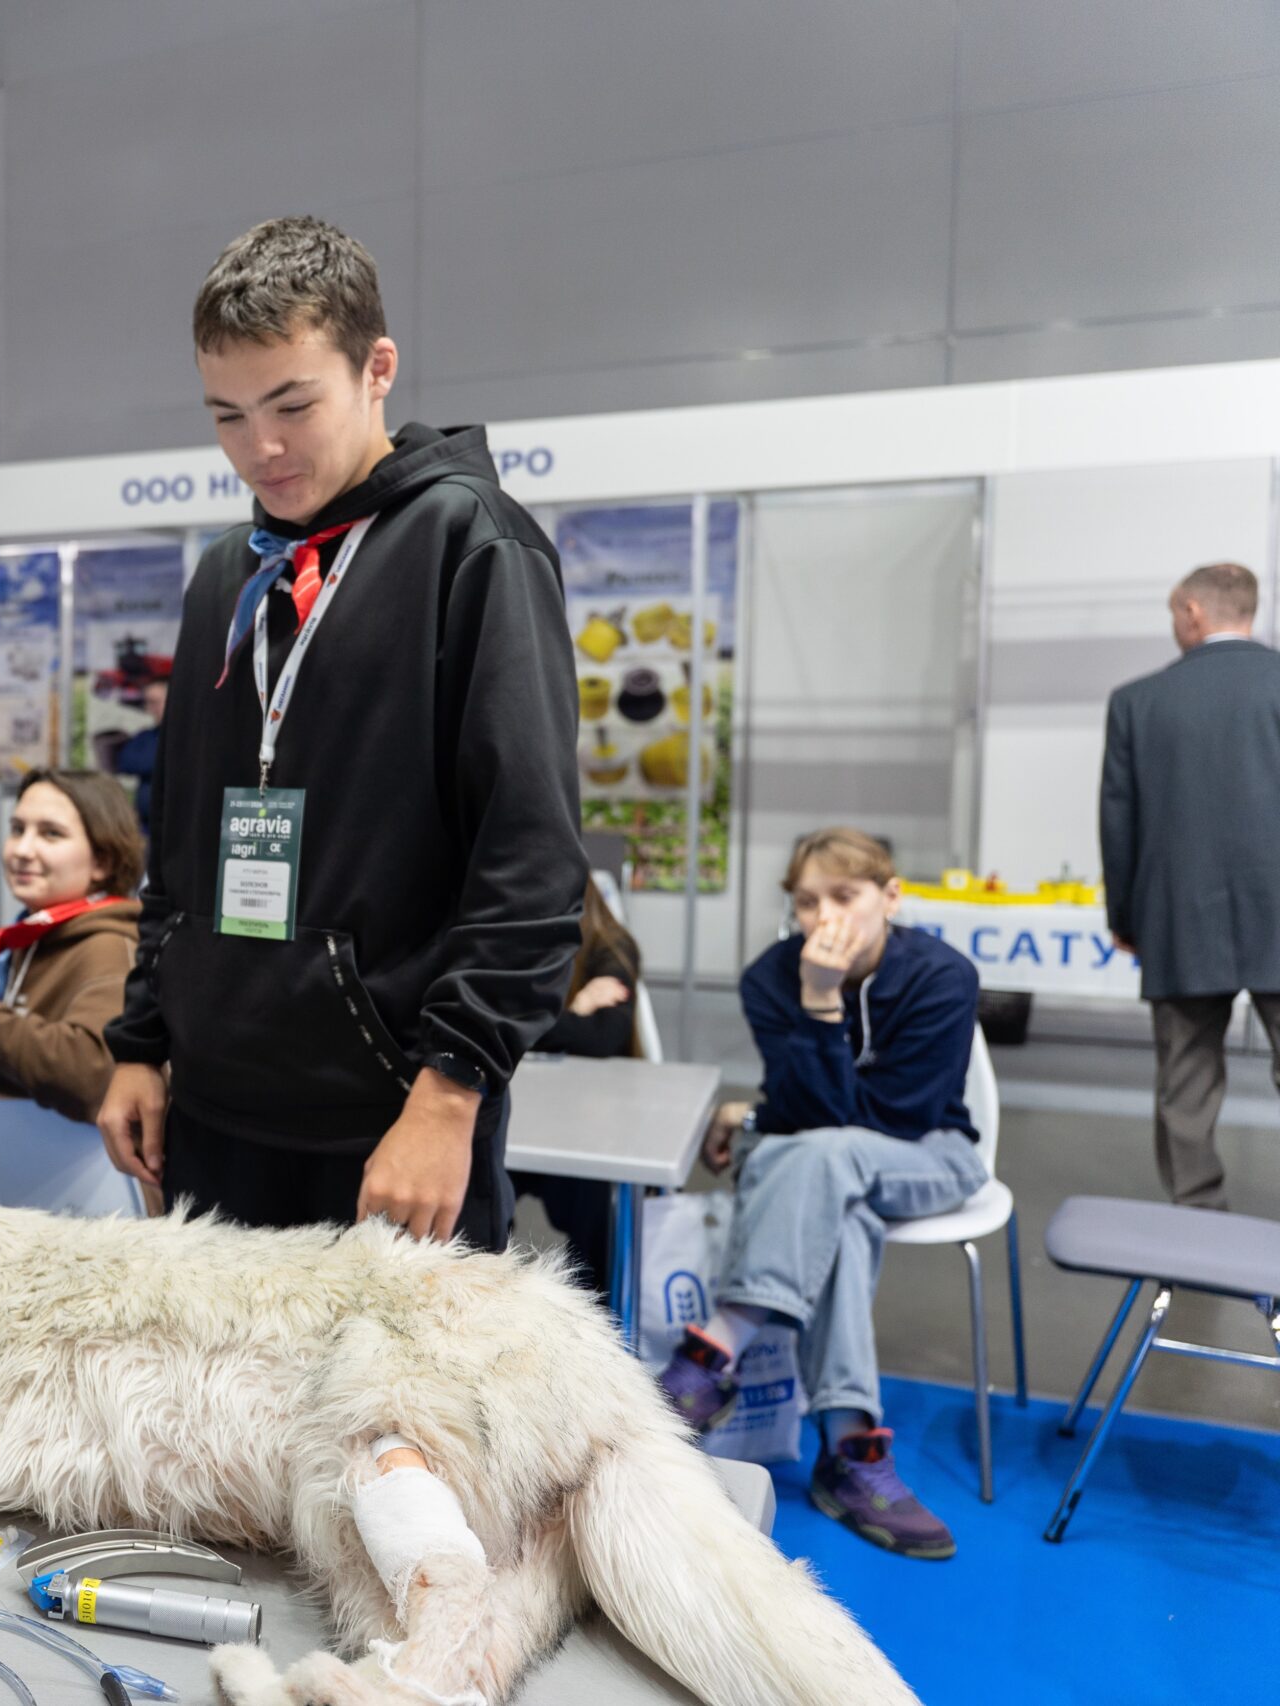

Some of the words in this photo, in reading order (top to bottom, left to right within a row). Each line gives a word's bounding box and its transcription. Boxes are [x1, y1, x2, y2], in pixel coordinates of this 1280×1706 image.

[491, 448, 554, 477] РО
[121, 475, 194, 506] ООО
[230, 815, 291, 837] agravia
[972, 925, 1142, 969] САТУ
